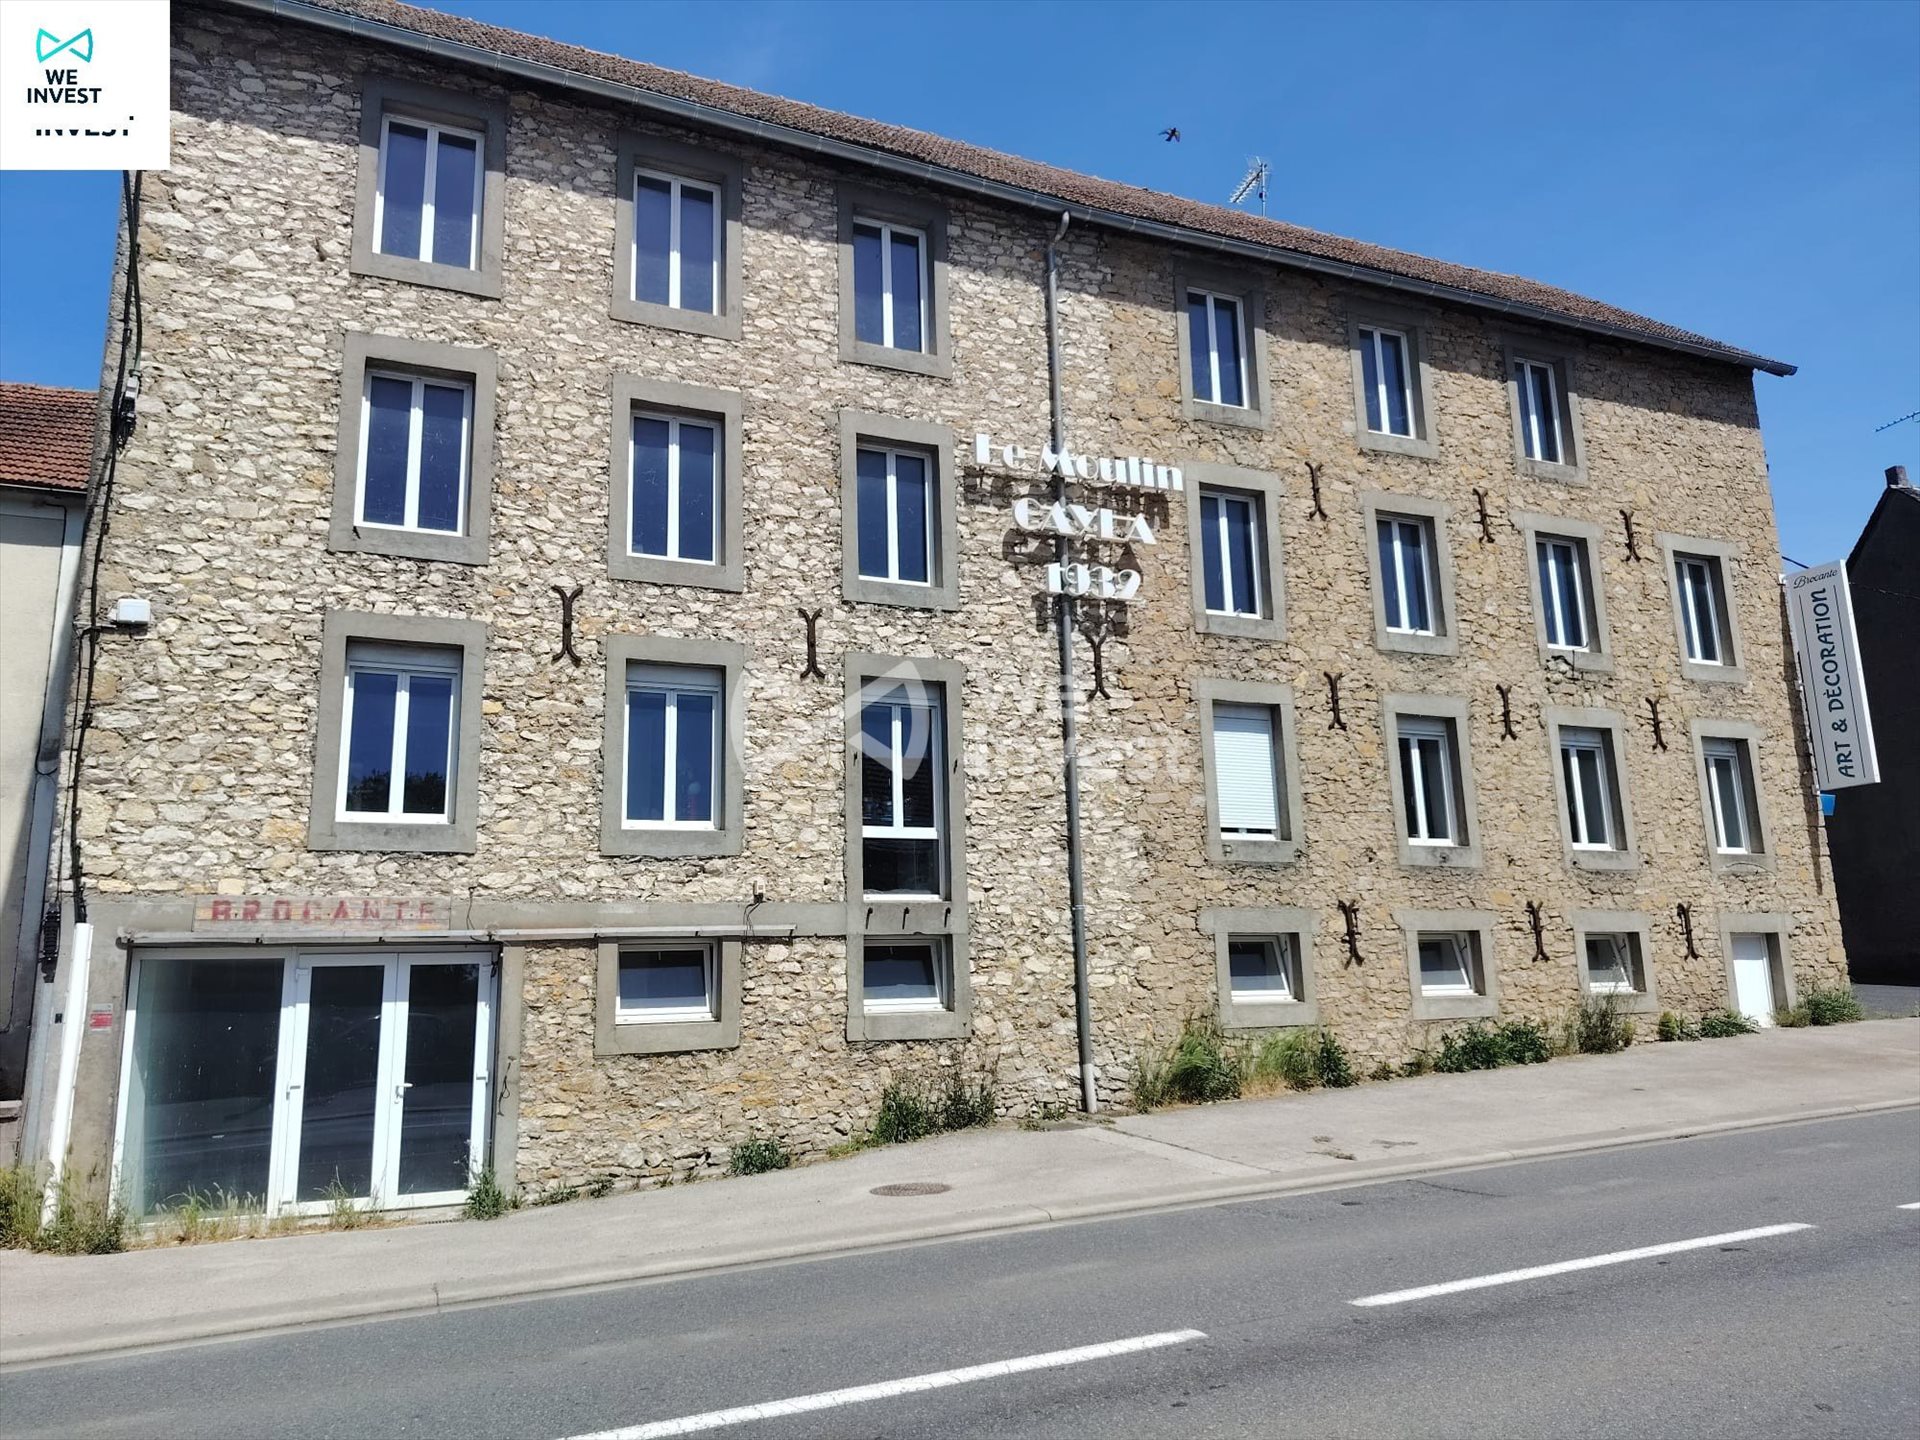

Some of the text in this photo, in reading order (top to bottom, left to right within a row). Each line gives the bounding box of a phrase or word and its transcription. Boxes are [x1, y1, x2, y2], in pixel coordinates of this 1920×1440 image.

[976, 433, 1184, 491] Le Moulin
[1013, 497, 1157, 545] CAYLA
[1043, 562, 1144, 602] 1932
[1793, 569, 1838, 589] Brocante
[1831, 718, 1849, 733] &
[1834, 741, 1856, 778] ART
[211, 899, 434, 923] BROCANTE
